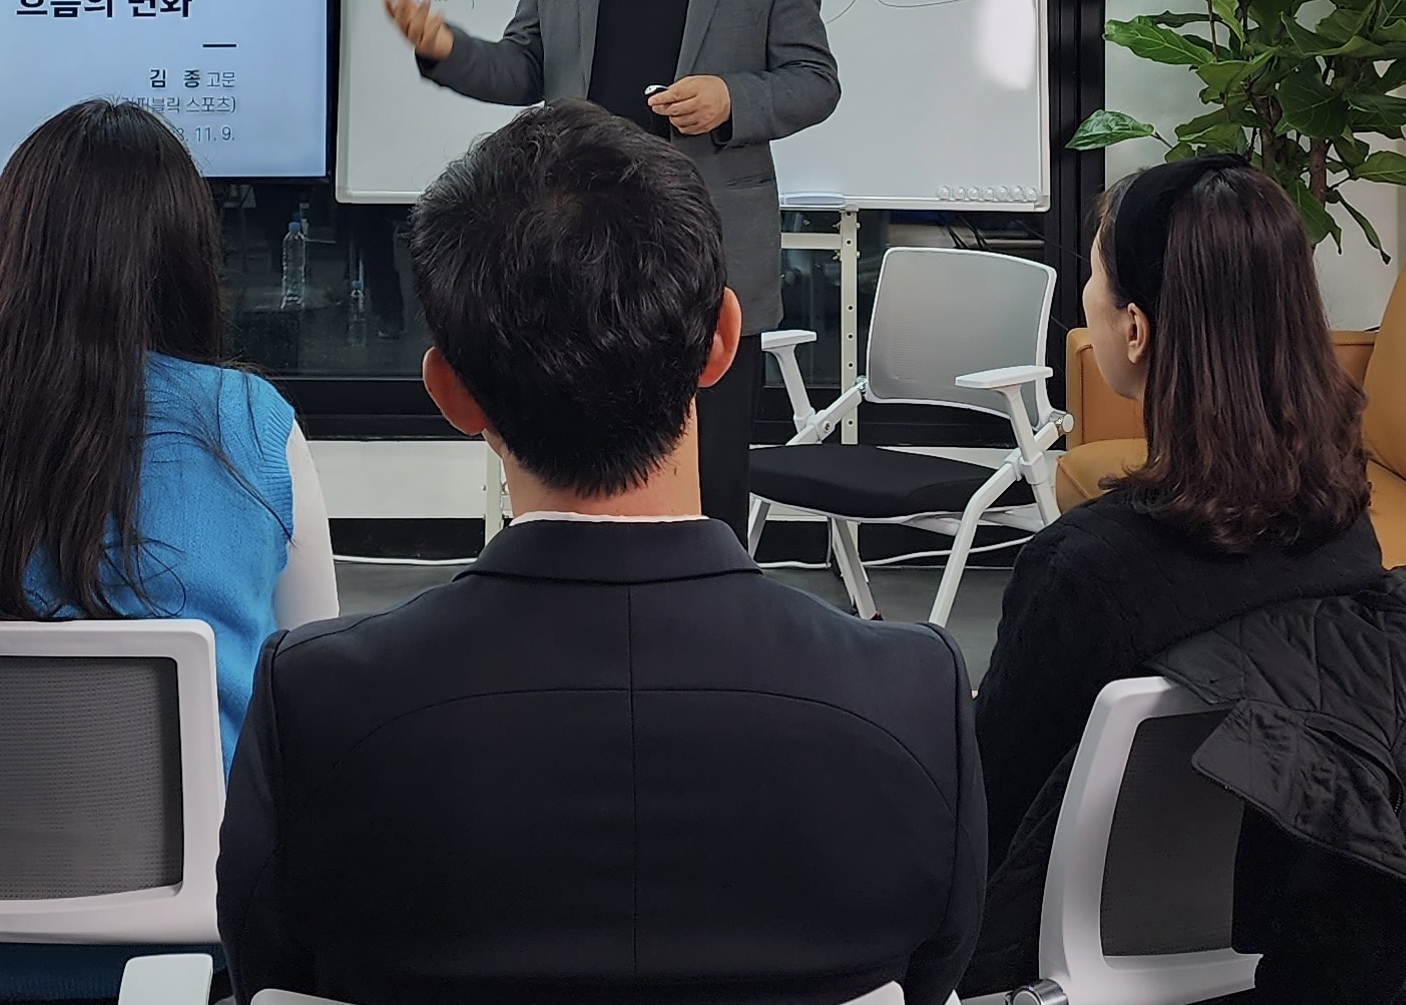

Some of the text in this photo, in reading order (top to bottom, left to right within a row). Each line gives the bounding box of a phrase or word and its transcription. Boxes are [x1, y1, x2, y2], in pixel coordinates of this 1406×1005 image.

[150, 69, 235, 88] 김 종 고문
[186, 96, 236, 113] 스포츠)
